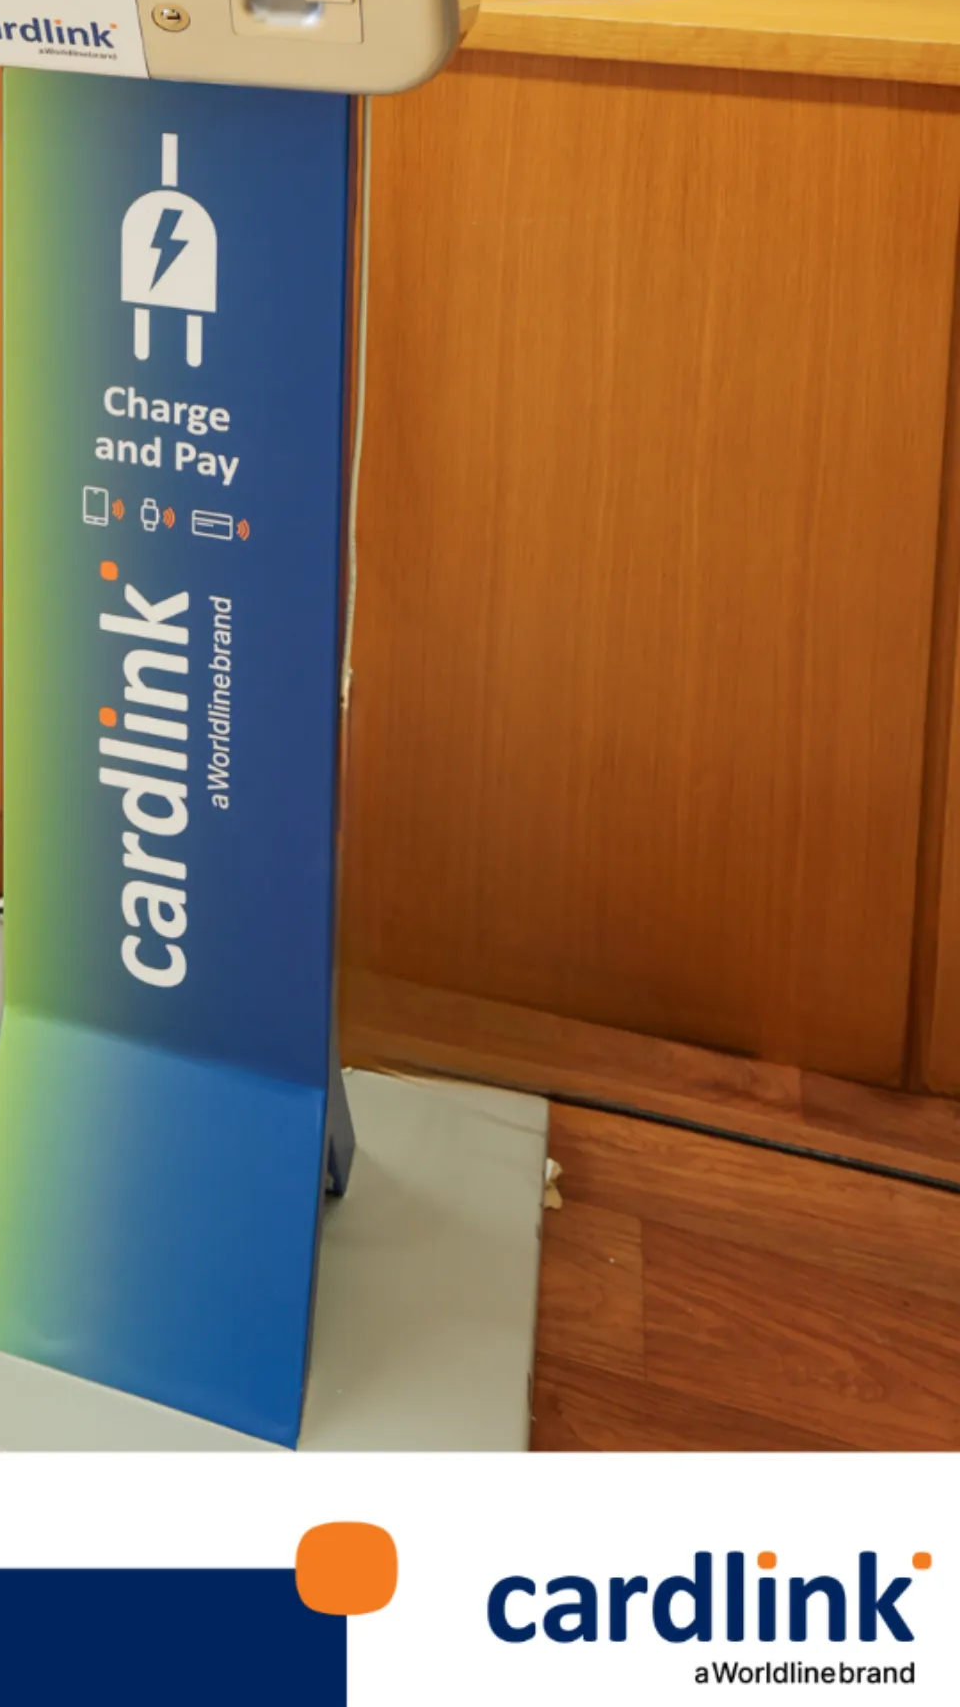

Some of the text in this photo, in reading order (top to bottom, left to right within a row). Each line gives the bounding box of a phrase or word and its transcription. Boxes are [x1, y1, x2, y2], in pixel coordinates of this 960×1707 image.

[103, 386, 230, 435] Charge
[94, 435, 240, 486] and Pay
[99, 583, 190, 988] cardlink
